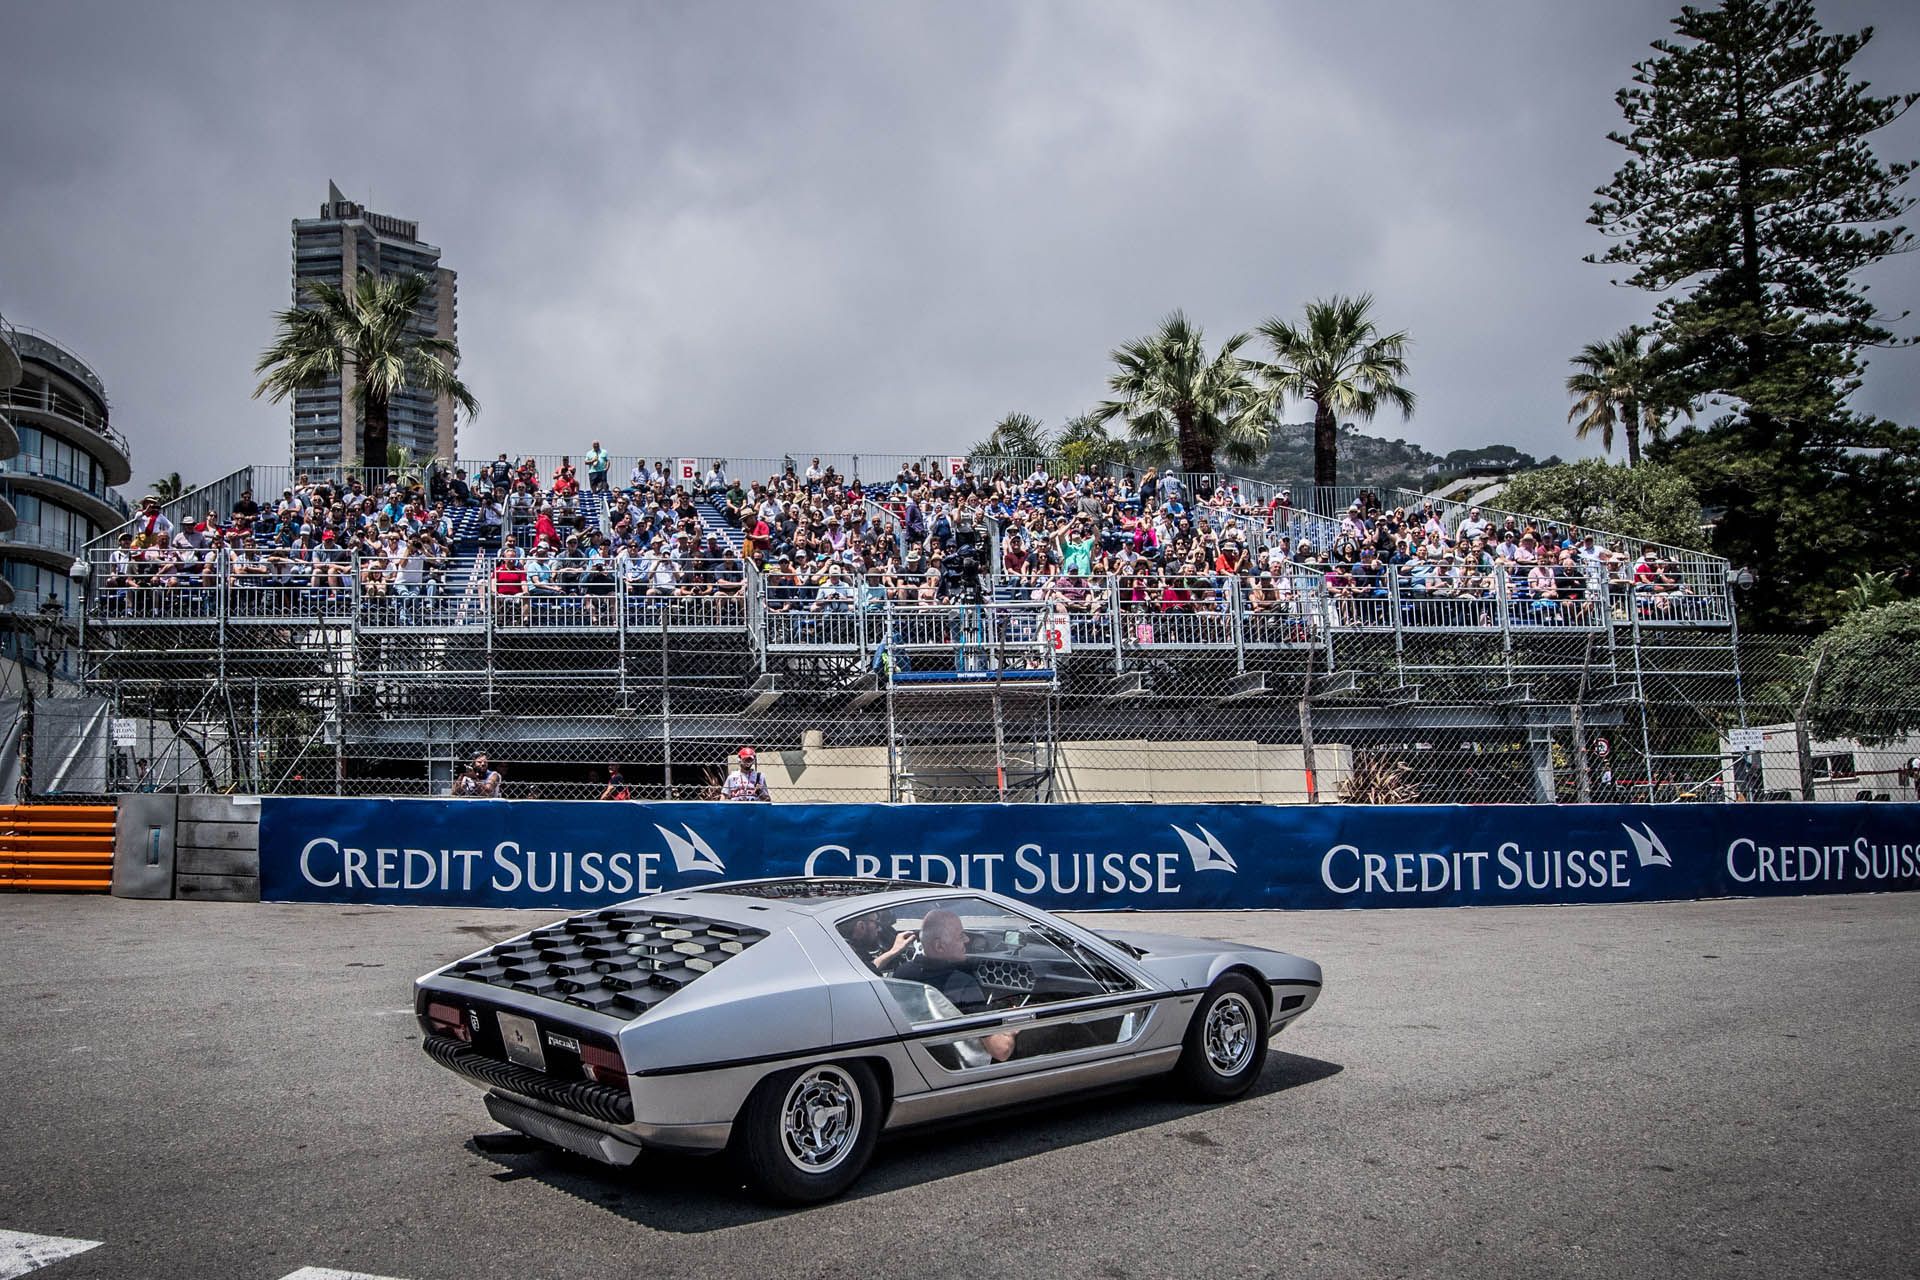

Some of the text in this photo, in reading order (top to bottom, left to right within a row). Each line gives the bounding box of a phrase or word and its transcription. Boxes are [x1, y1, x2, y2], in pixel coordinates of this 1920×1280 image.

[684, 466, 693, 478] B
[300, 837, 663, 894] CREDIT SUISSE
[1014, 843, 1181, 894] SUISSE
[1321, 842, 1631, 894] CREDIT SUISSE
[1727, 838, 1850, 882] CREDIT
